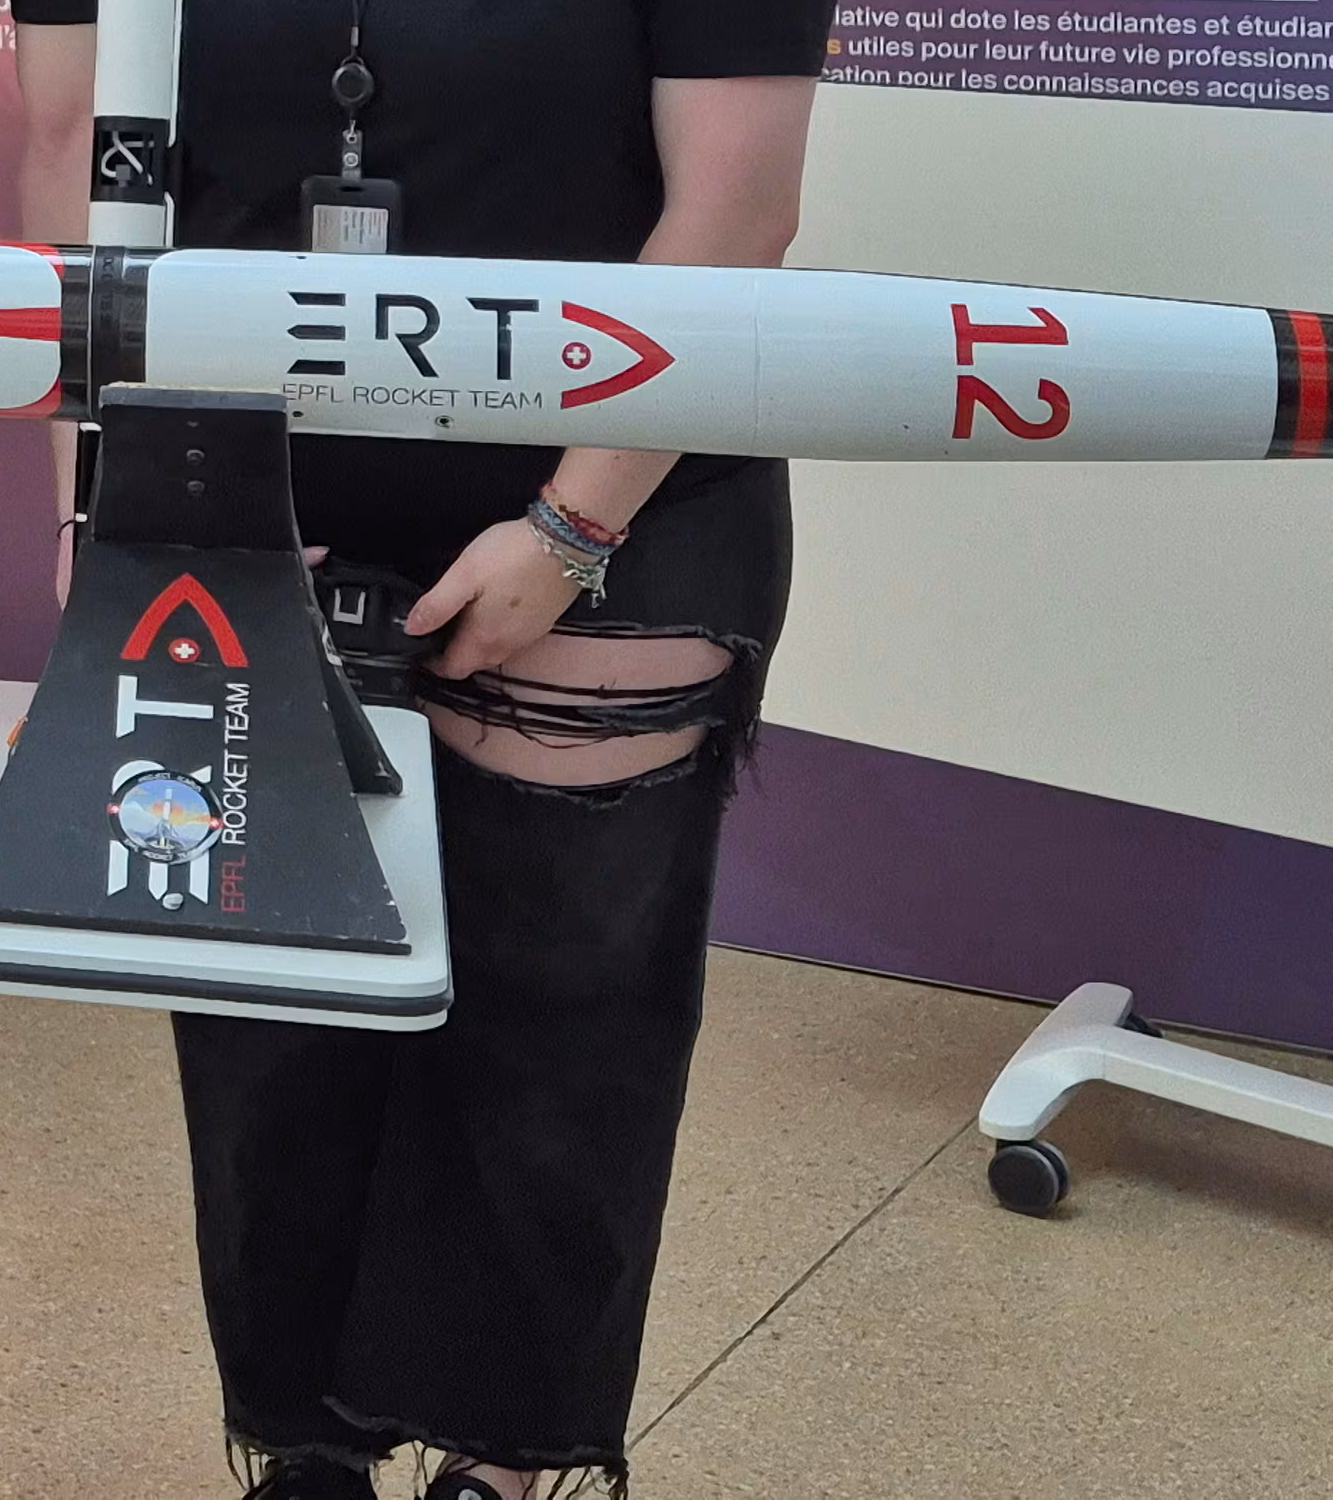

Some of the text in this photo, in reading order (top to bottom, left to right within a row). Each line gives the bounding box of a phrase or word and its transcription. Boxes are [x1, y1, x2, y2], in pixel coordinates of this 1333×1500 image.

[905, 7, 943, 33] qui
[949, 7, 1008, 30] dote
[1013, 9, 1051, 32] les
[1057, 10, 1197, 35] étudiantes
[1203, 15, 1231, 36] et
[848, 35, 915, 58] utiles
[921, 41, 979, 63] pour
[984, 38, 1034, 61] leur
[1038, 40, 1117, 64] future
[1122, 43, 1161, 65] vie
[961, 67, 998, 90] les
[1003, 72, 1200, 97] connaissances
[1205, 77, 1330, 104] acquises
[286, 291, 539, 380] ERT
[950, 303, 1071, 440] 12
[283, 383, 542, 410] EPFL ROCKET TEAM
[221, 682, 251, 913] EPFL ROCKET TEAM
